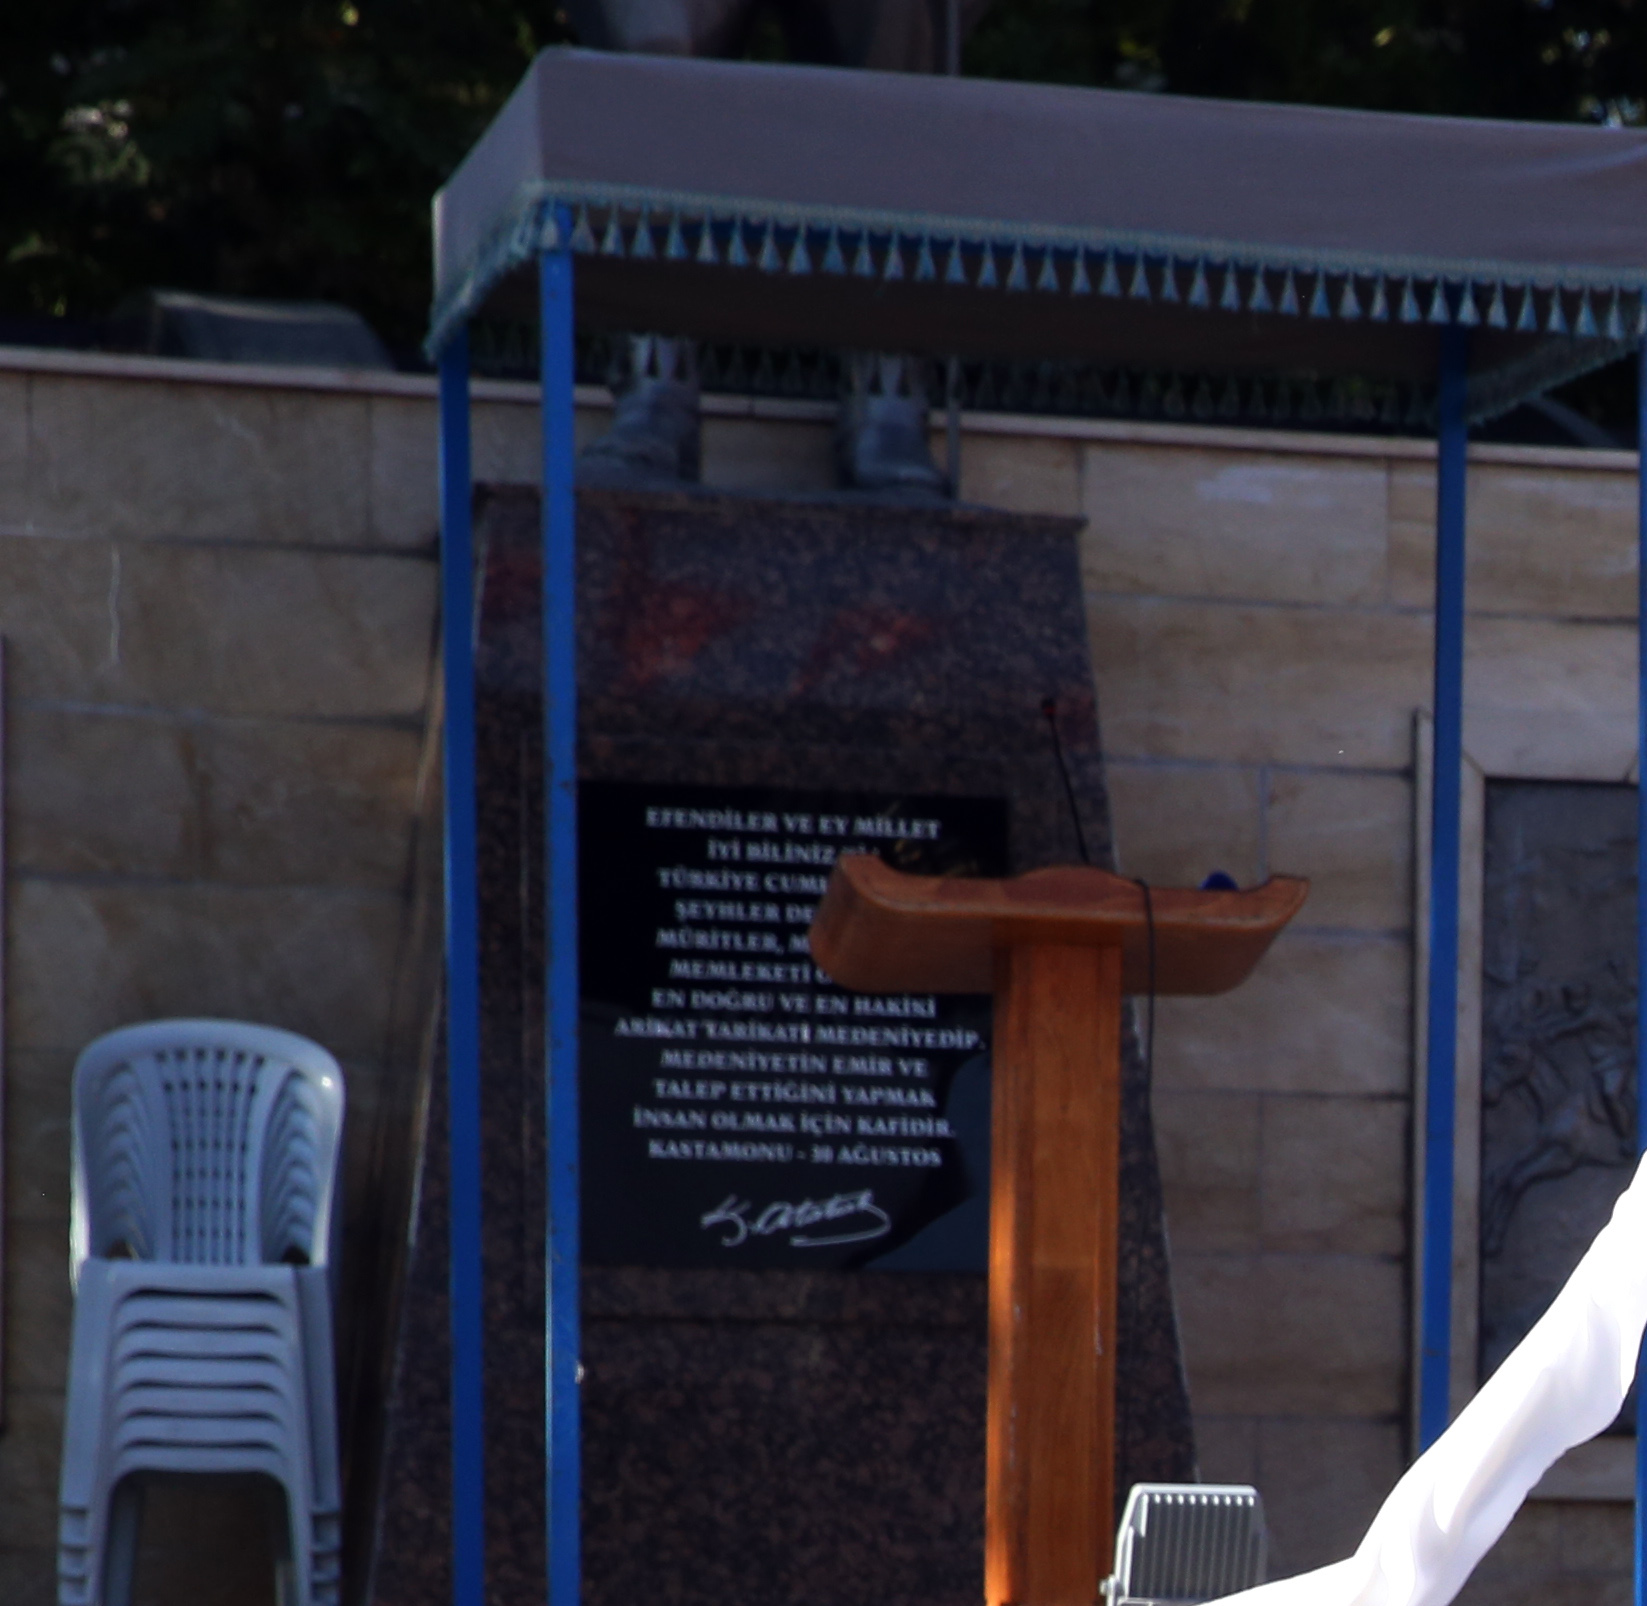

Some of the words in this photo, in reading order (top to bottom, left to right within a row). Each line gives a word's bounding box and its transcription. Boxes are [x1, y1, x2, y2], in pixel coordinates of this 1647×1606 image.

[782, 813, 812, 833] VE
[819, 815, 848, 835] EY
[853, 816, 940, 840] MİLLET
[708, 839, 740, 860] İYİ
[746, 841, 837, 864] BİLİNİZ
[657, 866, 759, 891] TÜRKİYE
[670, 959, 810, 983] MEMLEKETİ
[652, 988, 685, 1007] EN
[691, 989, 774, 1011] DOĞRU
[779, 994, 808, 1013] VE
[815, 995, 848, 1014] EN
[661, 1050, 827, 1073] MEDENİYETİN
[832, 1056, 892, 1075] EMİR
[896, 1058, 927, 1077] VE
[654, 1079, 726, 1099] TALEP
[730, 1081, 836, 1104] ETTİĞİNİ
[841, 1086, 935, 1107] YAPMAK
[633, 1105, 706, 1128] İNSAN
[711, 1112, 795, 1131] OLMAK
[800, 1113, 851, 1136] İÇİN
[648, 1139, 793, 1162] KASTAMONU
[837, 1143, 941, 1166] AĞUSTOS
